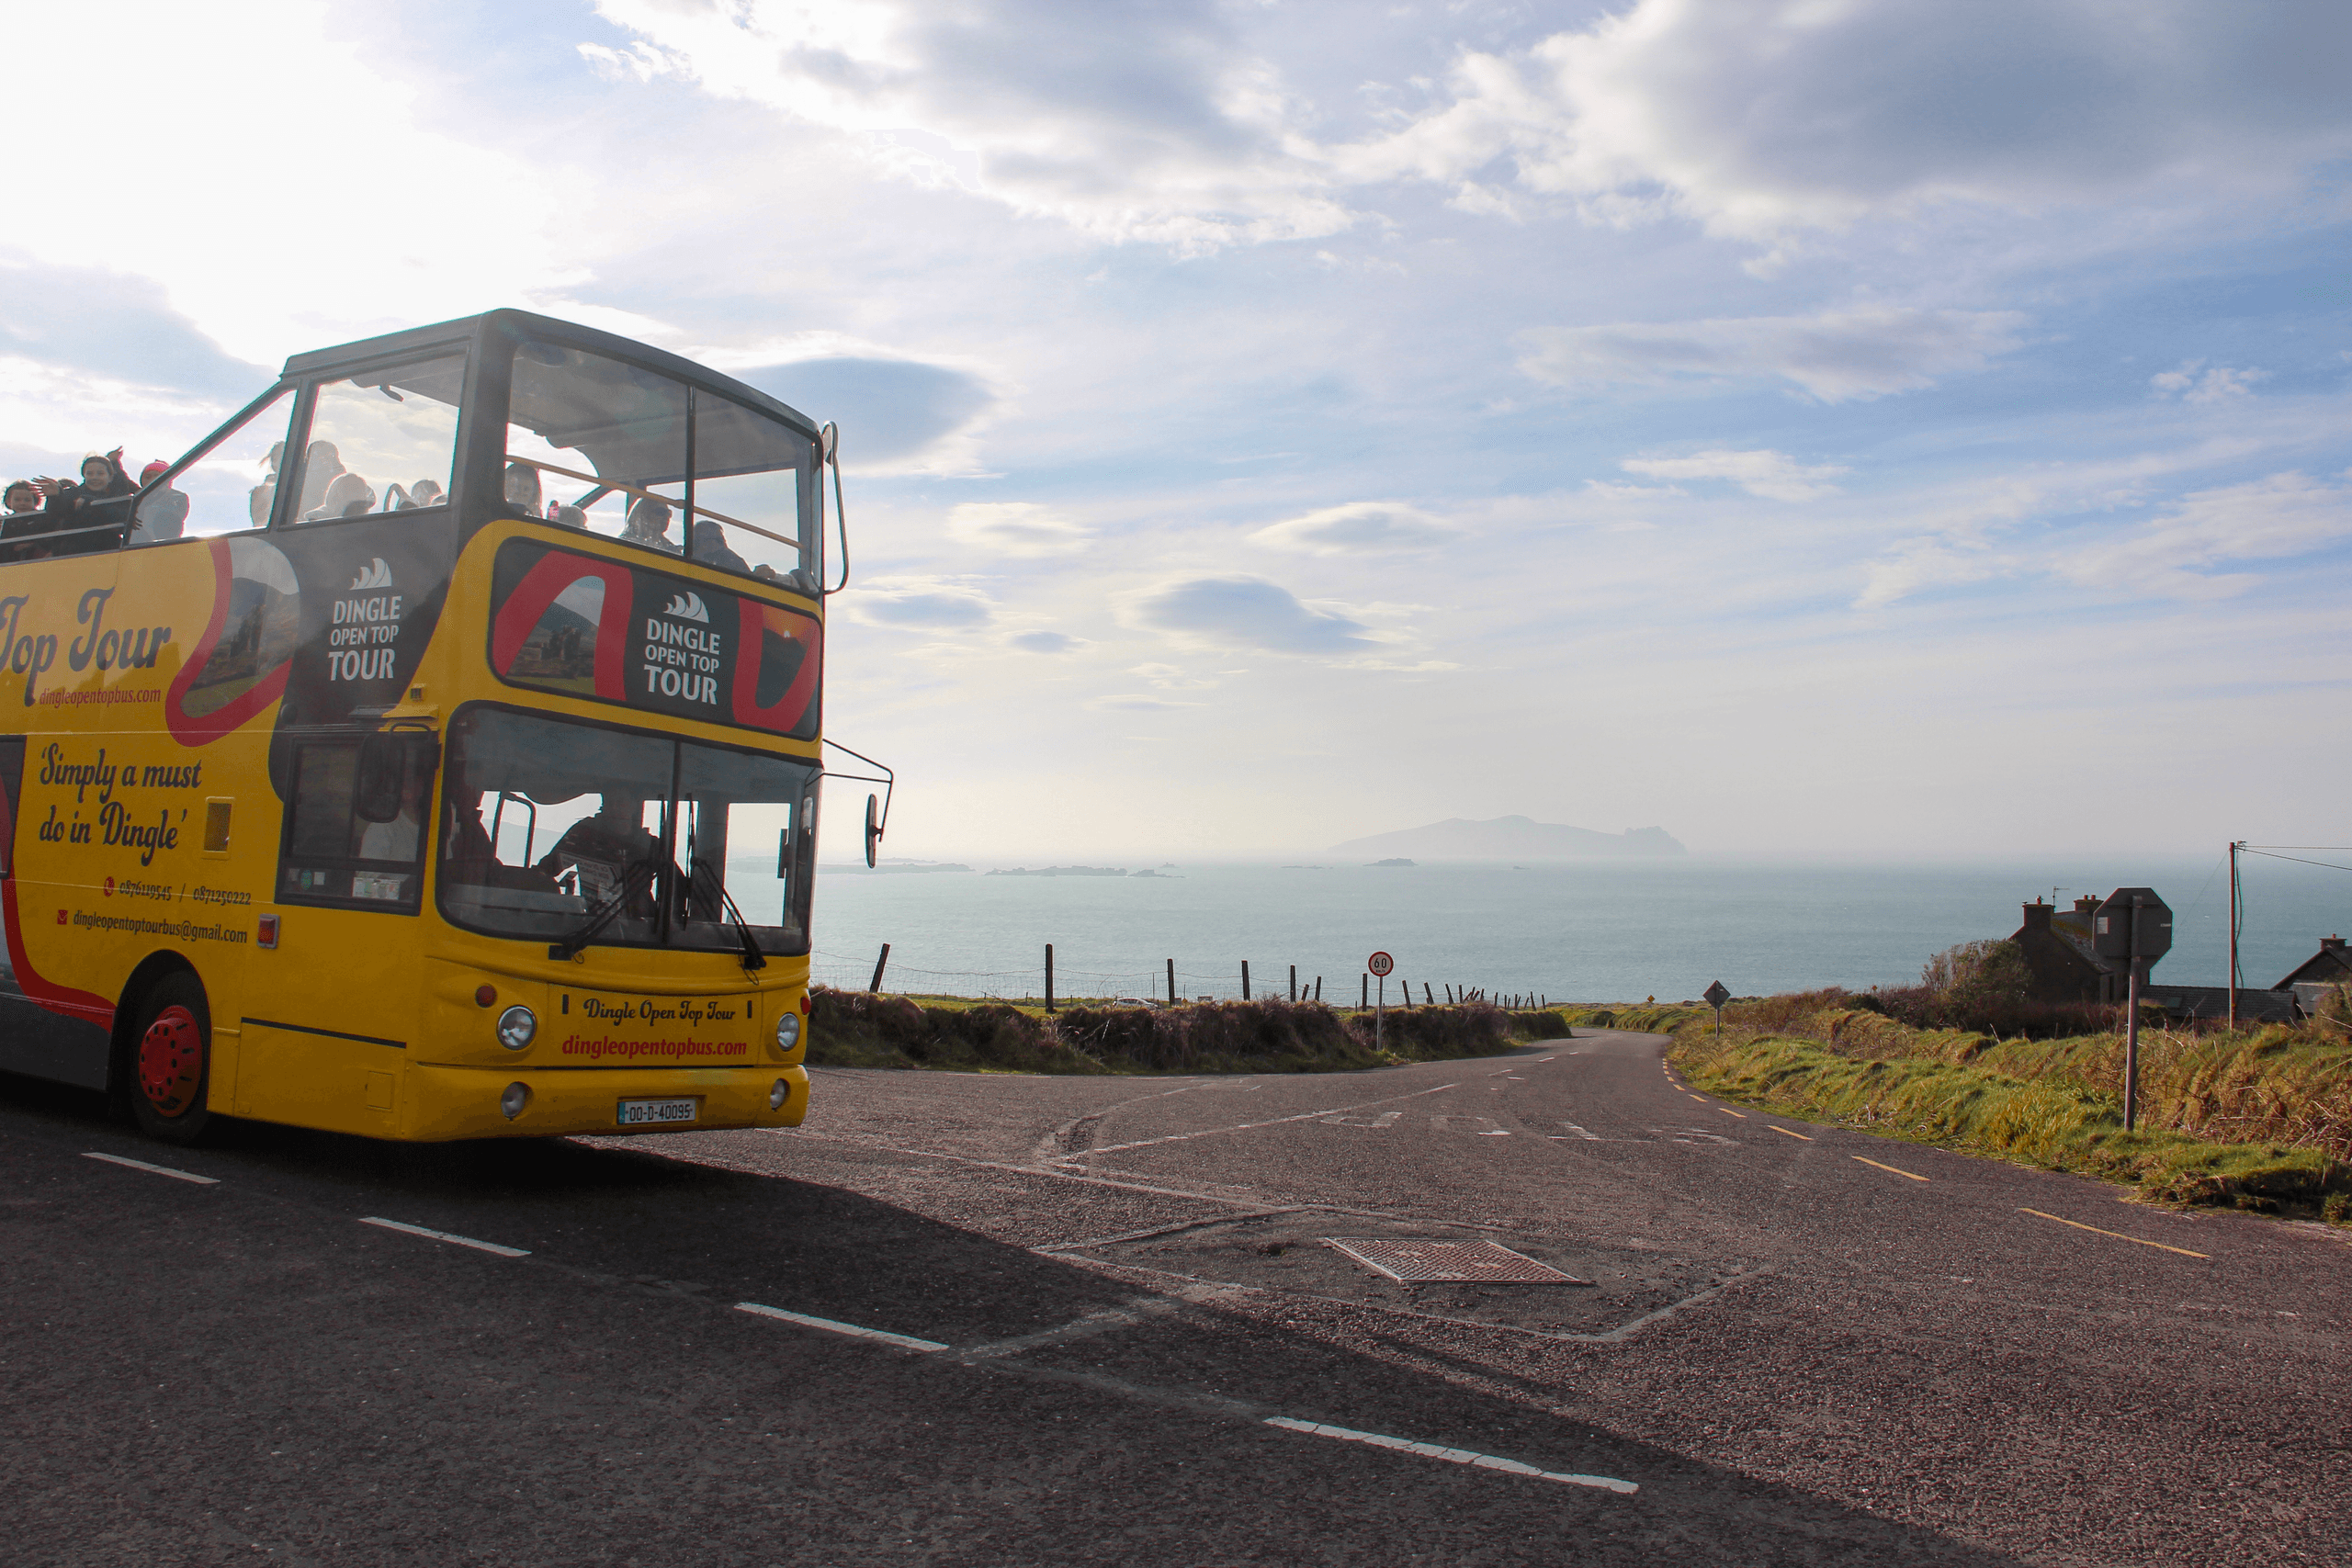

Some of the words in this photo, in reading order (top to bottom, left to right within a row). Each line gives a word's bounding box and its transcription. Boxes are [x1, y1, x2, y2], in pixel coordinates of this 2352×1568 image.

[333, 595, 401, 625] DINGLE
[0, 593, 58, 707] Top
[69, 585, 172, 671] Tour
[330, 626, 368, 646] OPEN
[371, 624, 400, 644] TOP
[647, 618, 720, 655] DINGLE
[328, 648, 396, 681] TOUR
[644, 644, 686, 668] OPEN
[690, 651, 720, 673] TOP
[40, 685, 161, 708] dingleopentopbus.com
[643, 665, 718, 705] TOUR
[121, 766, 137, 787] a
[141, 759, 202, 789] must
[39, 805, 65, 842] do
[69, 811, 92, 844] in
[73, 910, 248, 943] dingleopentoptourbus@gmail.com
[1374, 958, 1386, 968] 60
[583, 998, 636, 1026] Dingle
[639, 999, 675, 1026] Open
[679, 1000, 703, 1027] Top
[707, 1001, 736, 1021] Tour
[562, 1034, 747, 1059] dingleopentopbus.com
[629, 1104, 691, 1122] 00-D-40095
